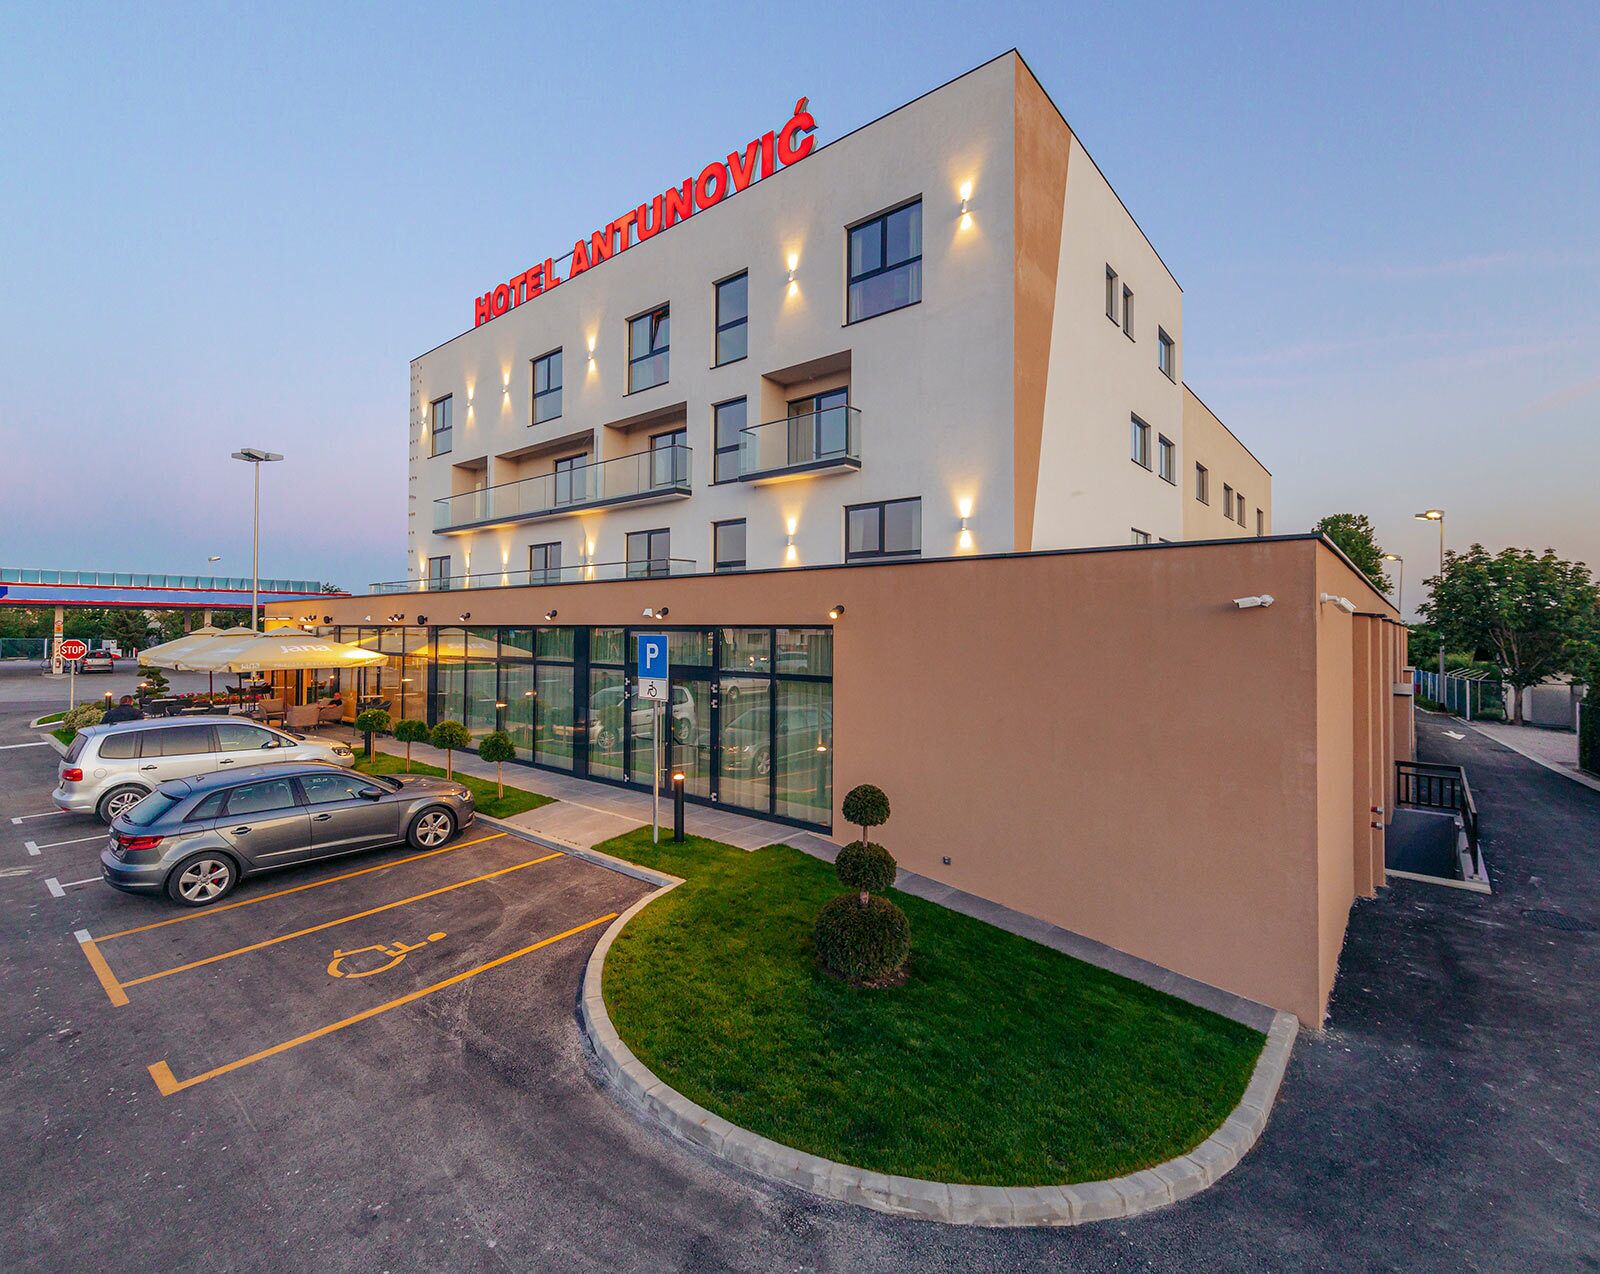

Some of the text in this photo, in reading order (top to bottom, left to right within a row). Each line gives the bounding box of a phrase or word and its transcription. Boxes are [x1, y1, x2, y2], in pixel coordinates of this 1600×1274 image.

[475, 96, 818, 327] HOTEL ANTUNOVIĆ
[61, 645, 84, 654] STOP
[646, 643, 659, 669] P
